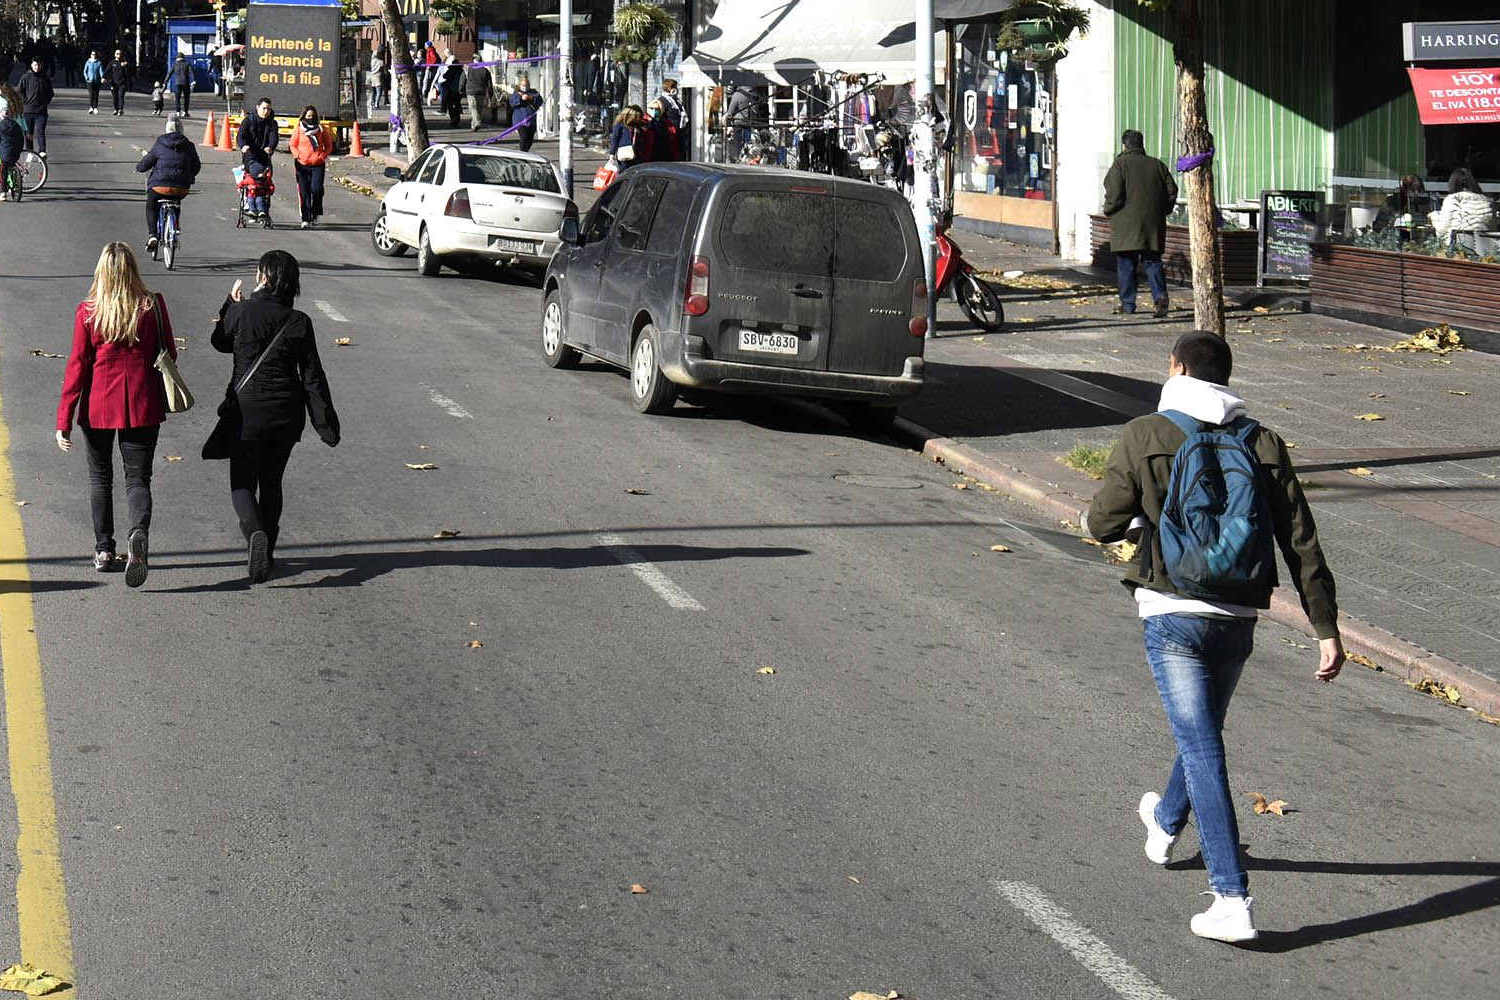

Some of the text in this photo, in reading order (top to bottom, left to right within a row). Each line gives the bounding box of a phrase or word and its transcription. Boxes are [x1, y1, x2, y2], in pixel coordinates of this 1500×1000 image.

[251, 35, 332, 52] Mantené la
[1421, 33, 1499, 47] HARRING
[259, 53, 324, 68] distancia
[260, 71, 321, 85] en la fila
[1451, 73, 1495, 86] HOY
[1429, 89, 1445, 98] TE
[1431, 102, 1447, 110] EL
[1448, 101, 1466, 110] IVA
[1267, 196, 1321, 213] ABIERTO
[717, 292, 759, 301] PEUGEOT
[743, 332, 796, 349] SBV 6830
